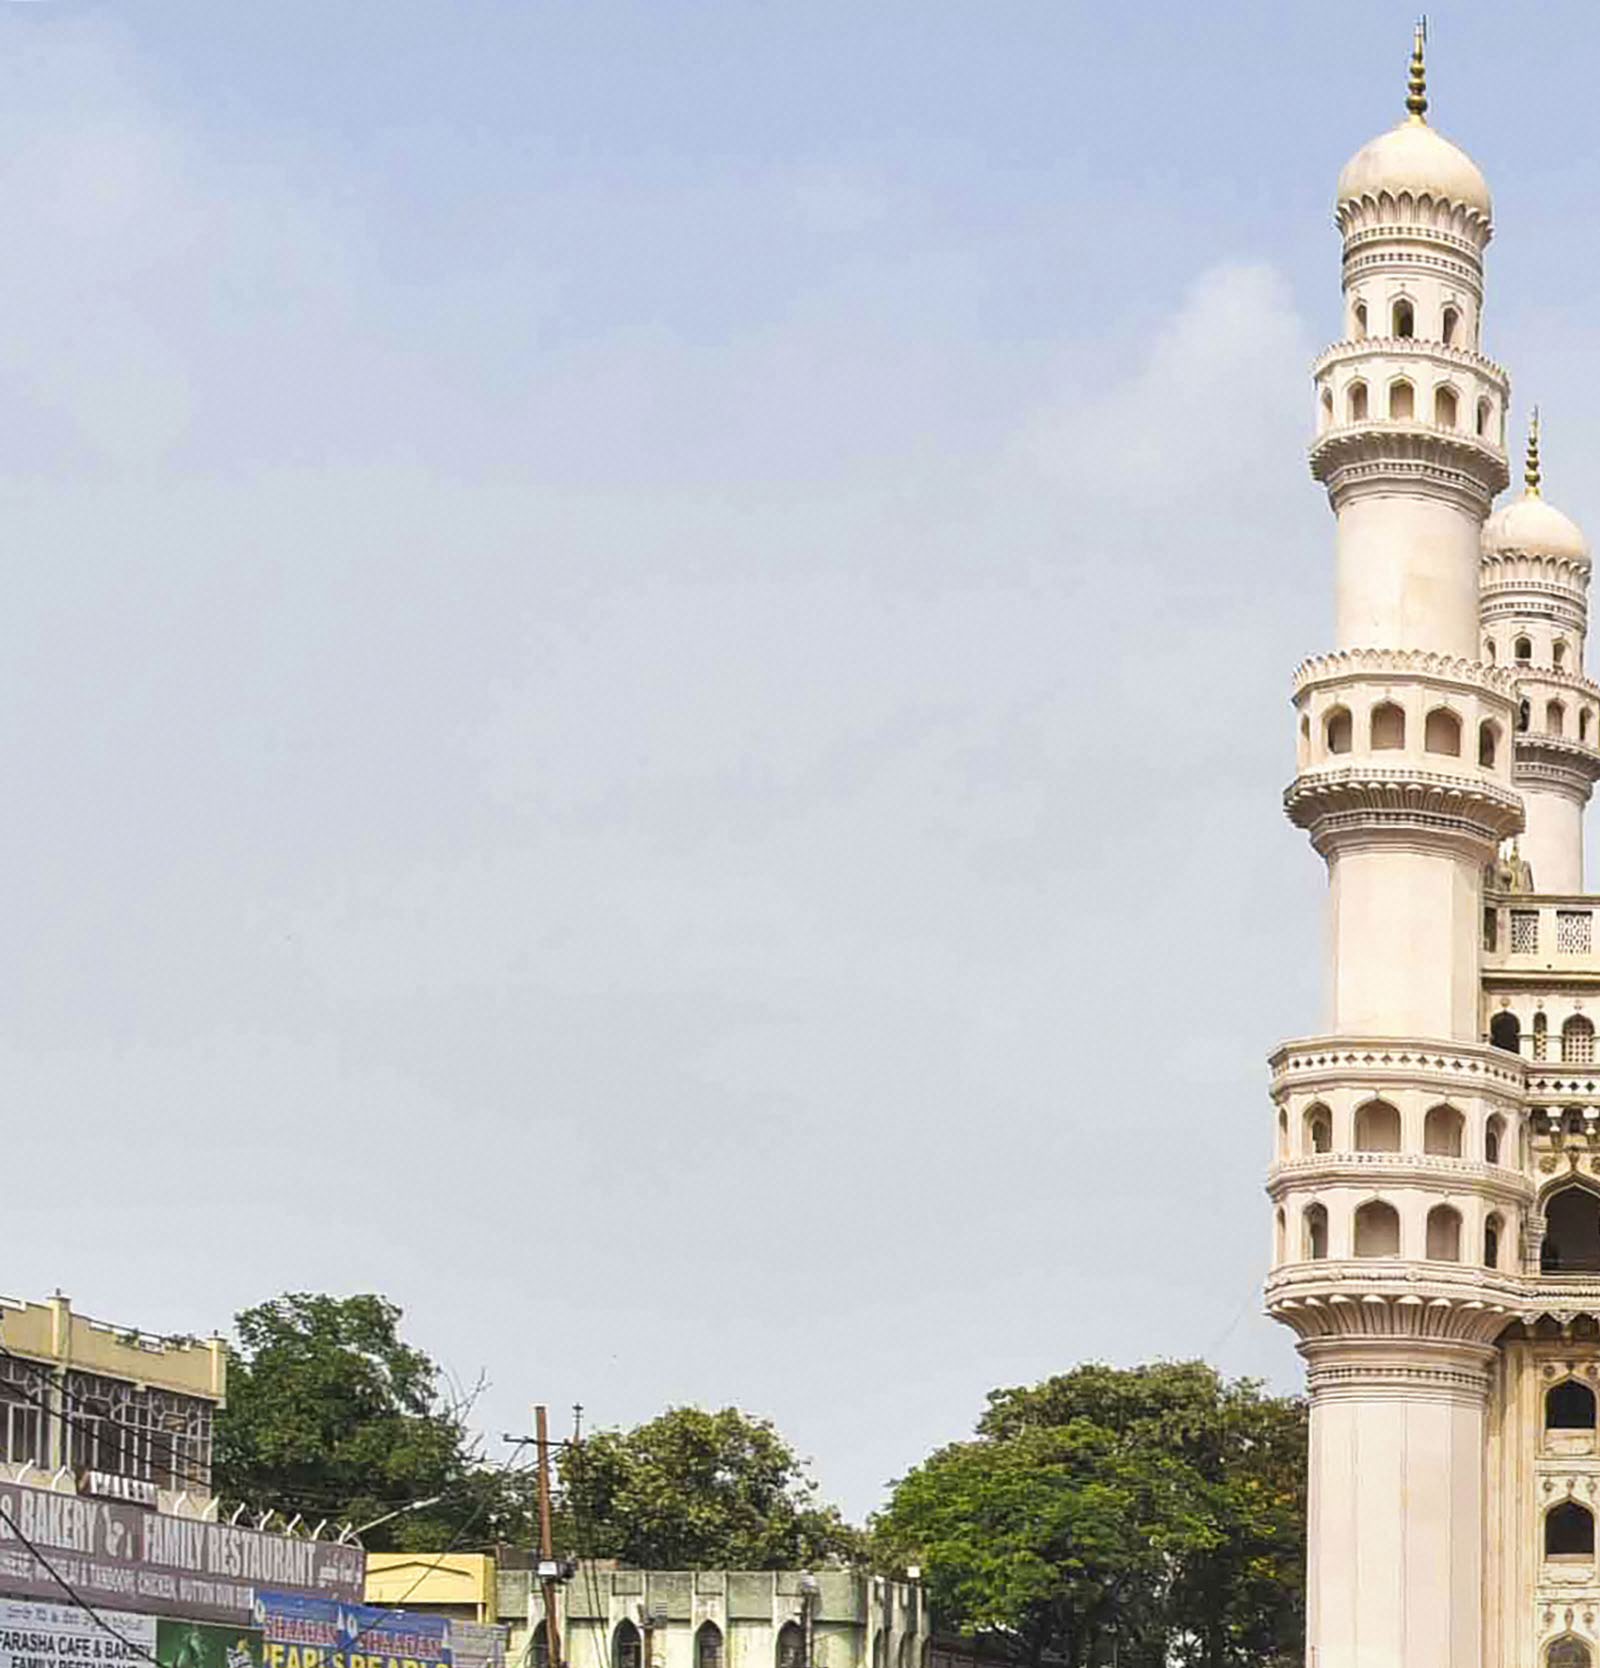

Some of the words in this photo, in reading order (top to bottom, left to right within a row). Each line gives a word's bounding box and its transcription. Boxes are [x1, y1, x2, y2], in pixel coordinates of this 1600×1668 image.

[21, 1490, 97, 1554] BAKERY
[143, 1513, 204, 1571] FAMILY
[208, 1526, 316, 1587] RESTAURANT
[58, 1637, 91, 1657] CAFE
[93, 1641, 101, 1658] &
